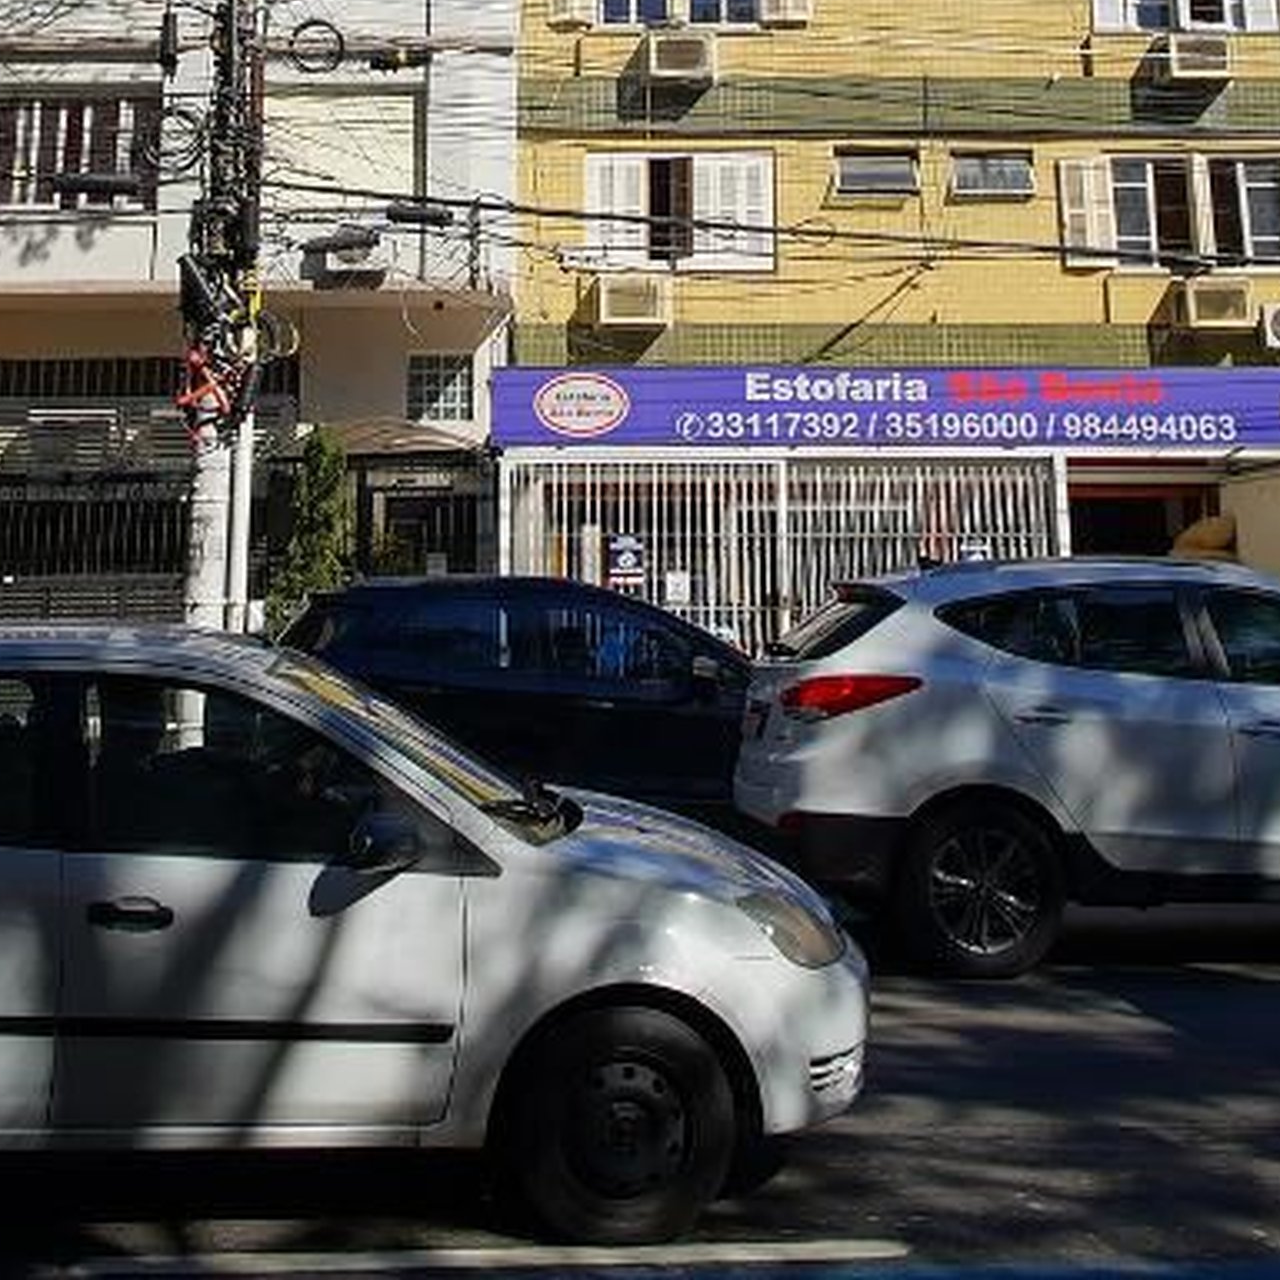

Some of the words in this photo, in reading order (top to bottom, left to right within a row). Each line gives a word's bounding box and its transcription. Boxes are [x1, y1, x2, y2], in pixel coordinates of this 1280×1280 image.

[746, 373, 928, 401] Estofaria
[707, 412, 859, 438] 33117392
[886, 412, 1038, 439] 35196000
[1063, 413, 1237, 440] 984494063
